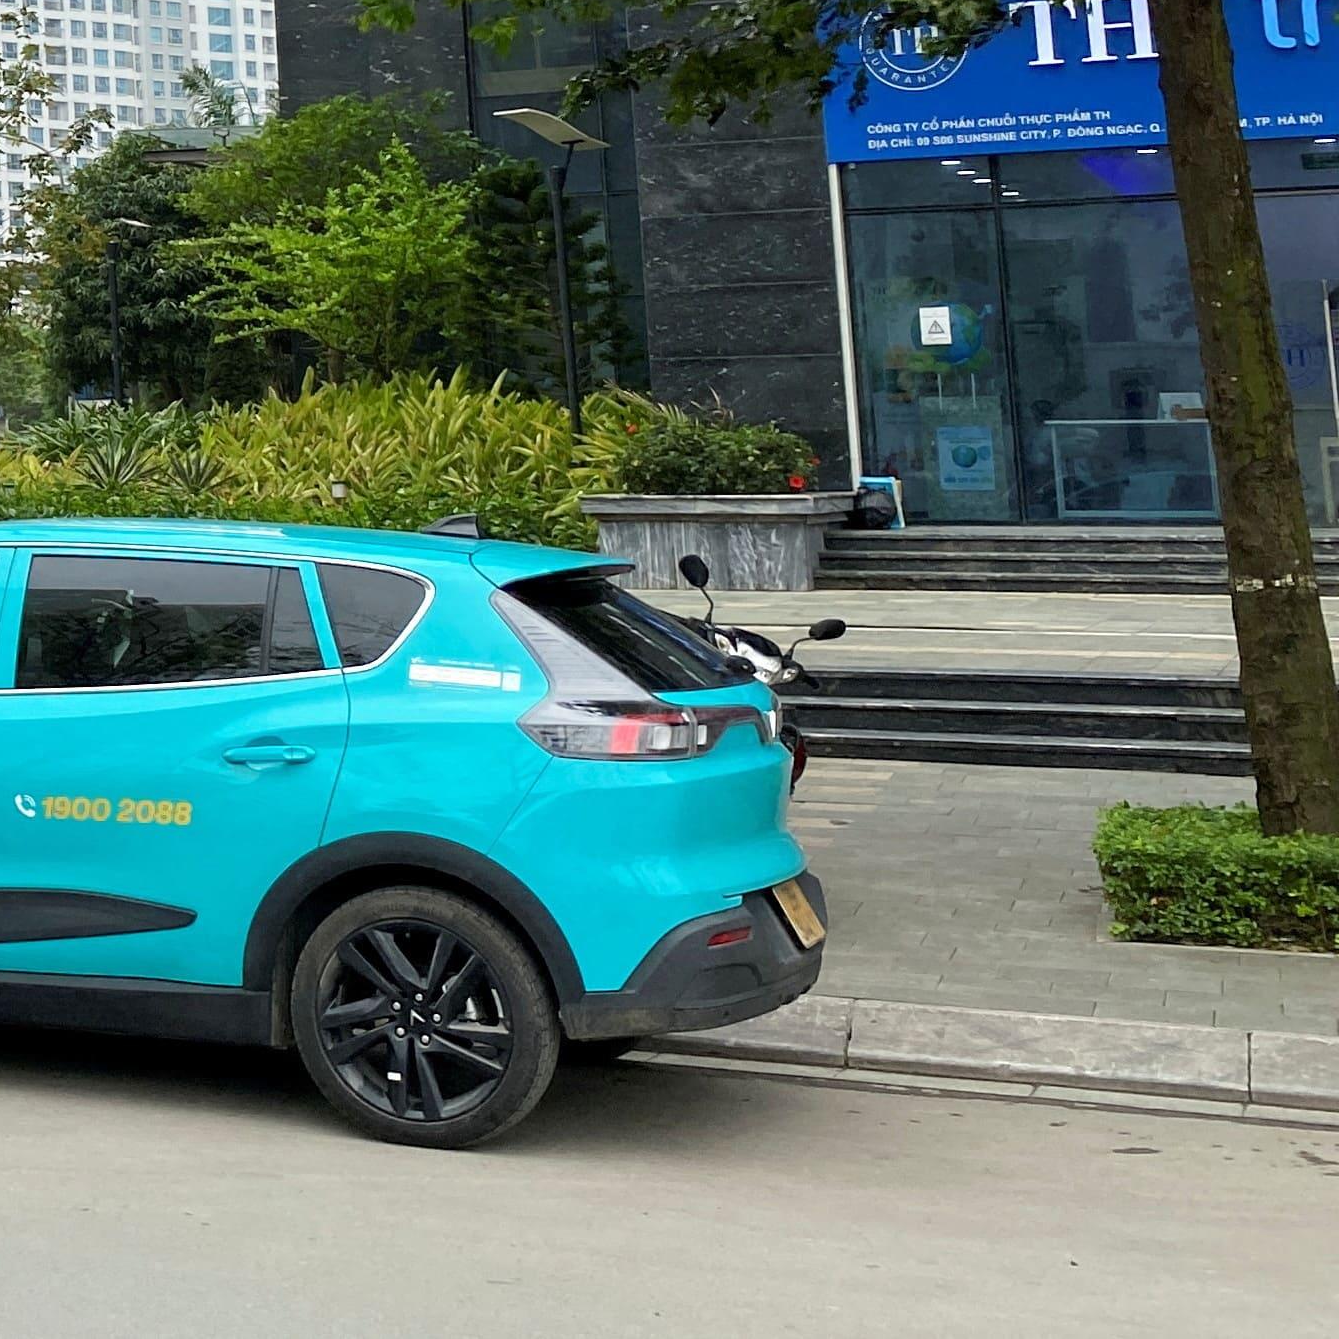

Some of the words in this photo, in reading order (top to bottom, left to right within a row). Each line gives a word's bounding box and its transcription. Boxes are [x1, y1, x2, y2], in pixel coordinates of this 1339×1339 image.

[867, 122, 901, 135] CÔNG
[904, 122, 919, 132] TY
[1093, 111, 1111, 120] TH
[956, 131, 1017, 144] SUNSHINE
[41, 796, 111, 822] 1900
[116, 798, 193, 826] 2088
